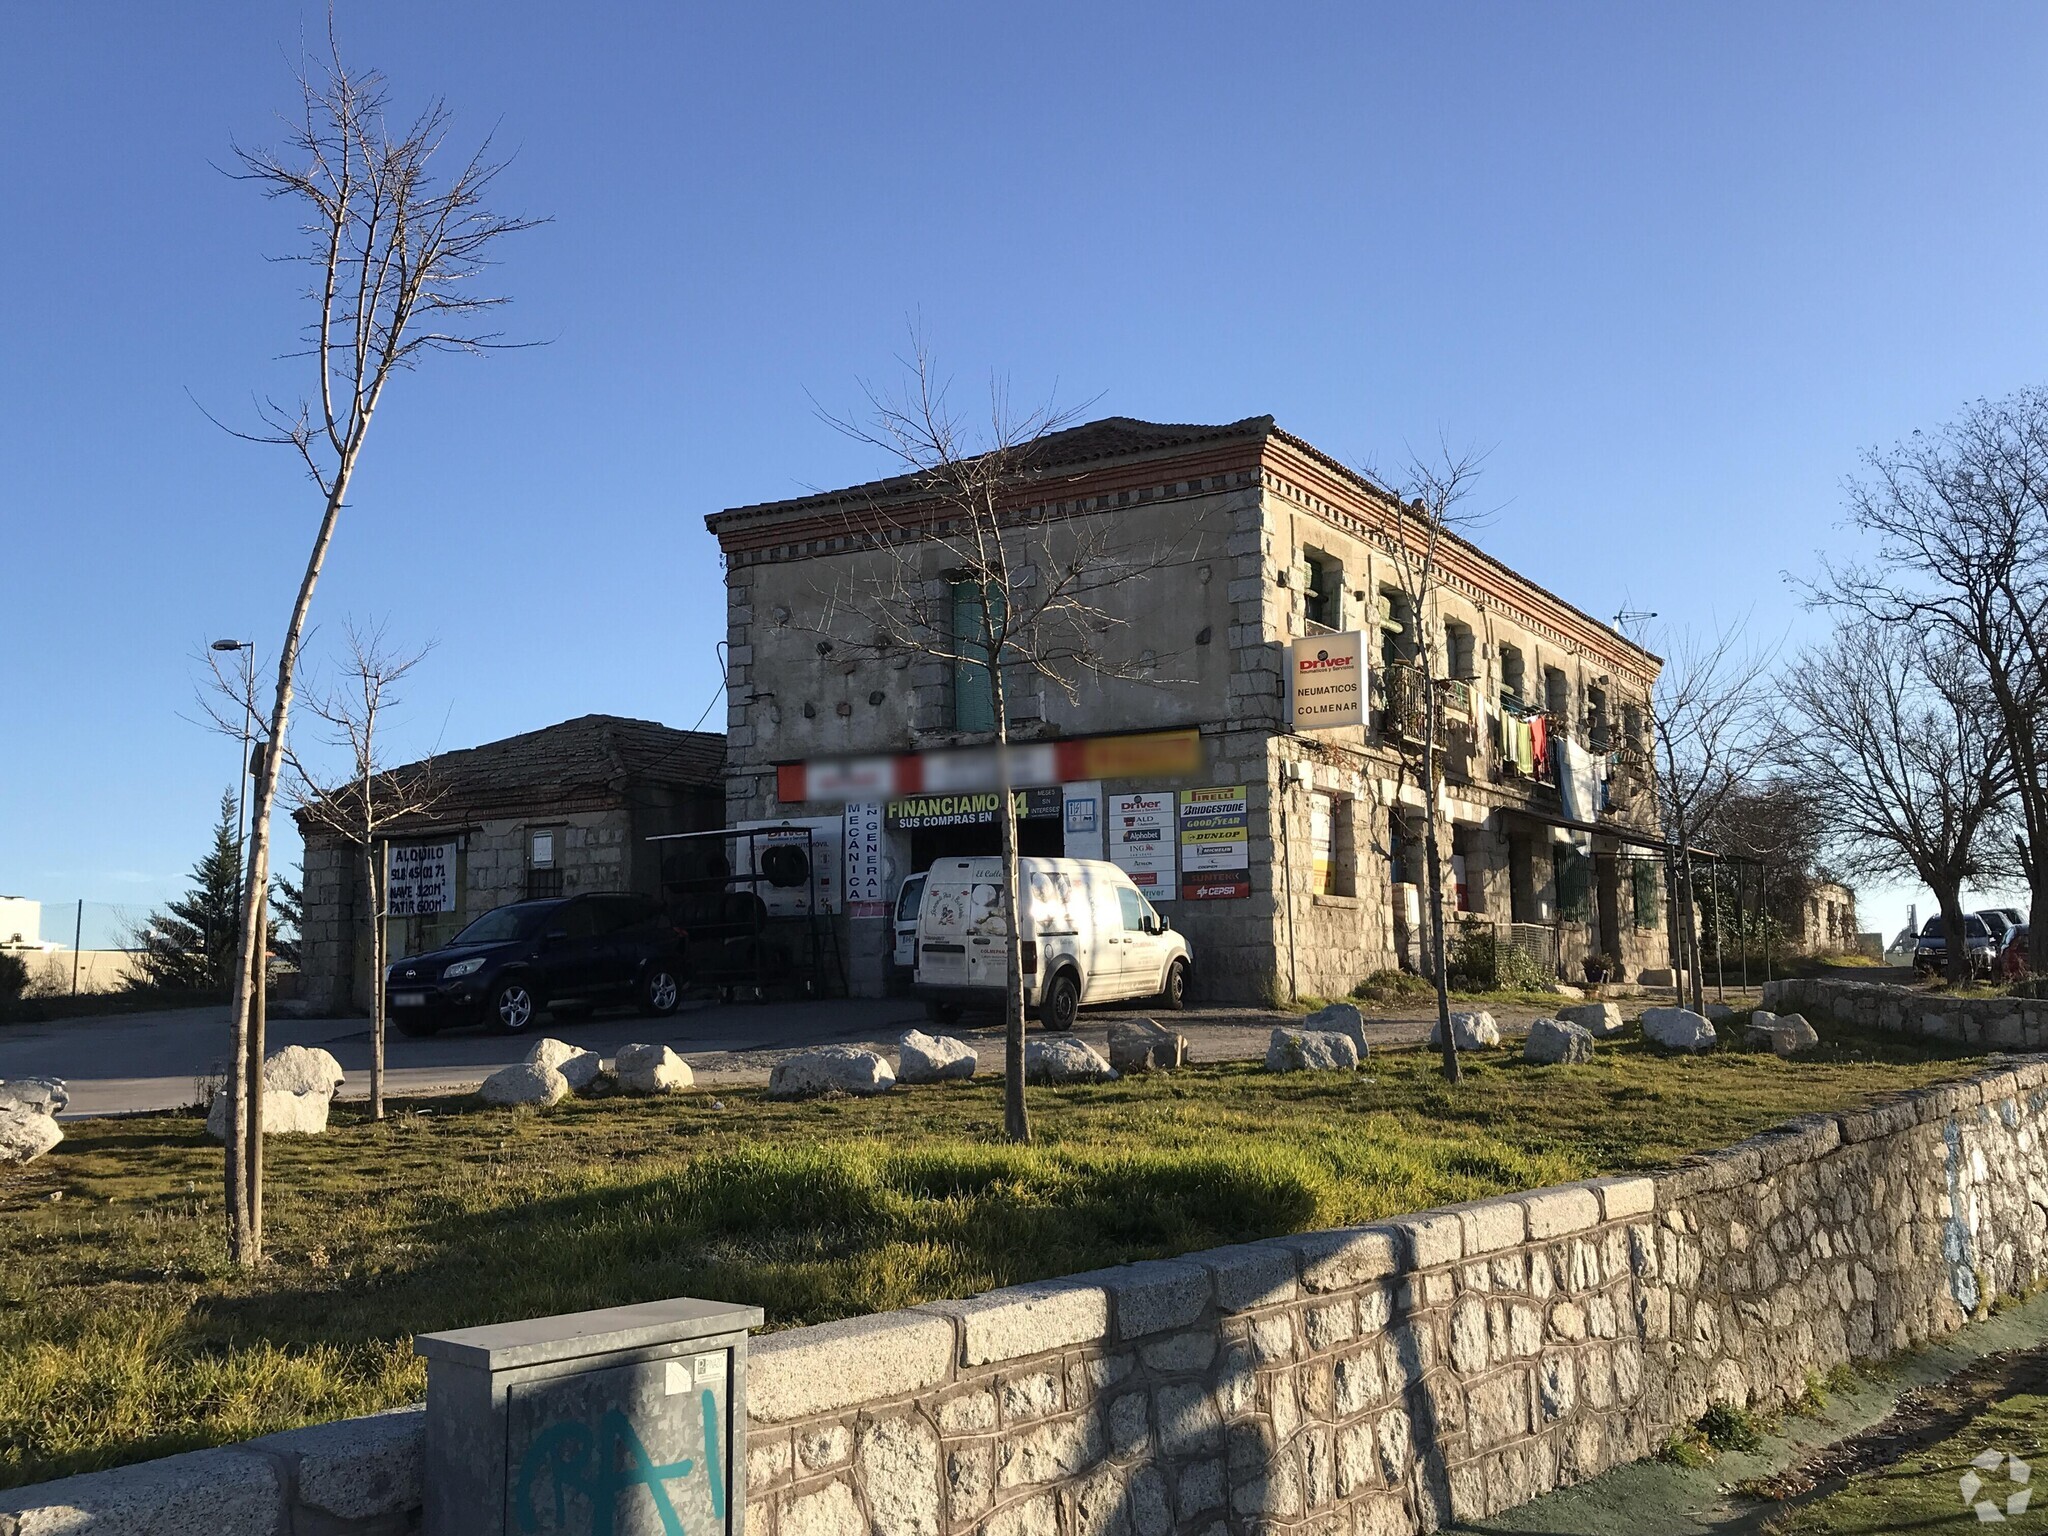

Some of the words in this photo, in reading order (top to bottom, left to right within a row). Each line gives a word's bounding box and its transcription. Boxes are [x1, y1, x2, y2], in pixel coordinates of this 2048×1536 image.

[1300, 656, 1353, 670] Driver
[1297, 683, 1358, 697] NEUMATICOS
[1297, 702, 1358, 715] COLMENAR
[1191, 788, 1234, 802] PIRELLI
[888, 793, 1001, 819] FINANCIAMO
[1031, 806, 1060, 814] INTERESES
[1121, 800, 1161, 810] Driver
[1183, 803, 1244, 816] BRIDGESTONE
[899, 817, 920, 829] SUS
[923, 814, 976, 828] COMPRAS
[979, 811, 993, 823] EN
[1187, 816, 1241, 828] GOODYEAR
[1129, 831, 1159, 841] Alphabet
[1195, 831, 1240, 840] DUNLOP
[395, 847, 444, 863] ALQUILO
[848, 803, 860, 900] MECÁNICA
[866, 821, 878, 898] GENERAL
[435, 864, 446, 877] 71
[390, 886, 413, 899] NAVE
[1208, 886, 1236, 896] CEPSA
